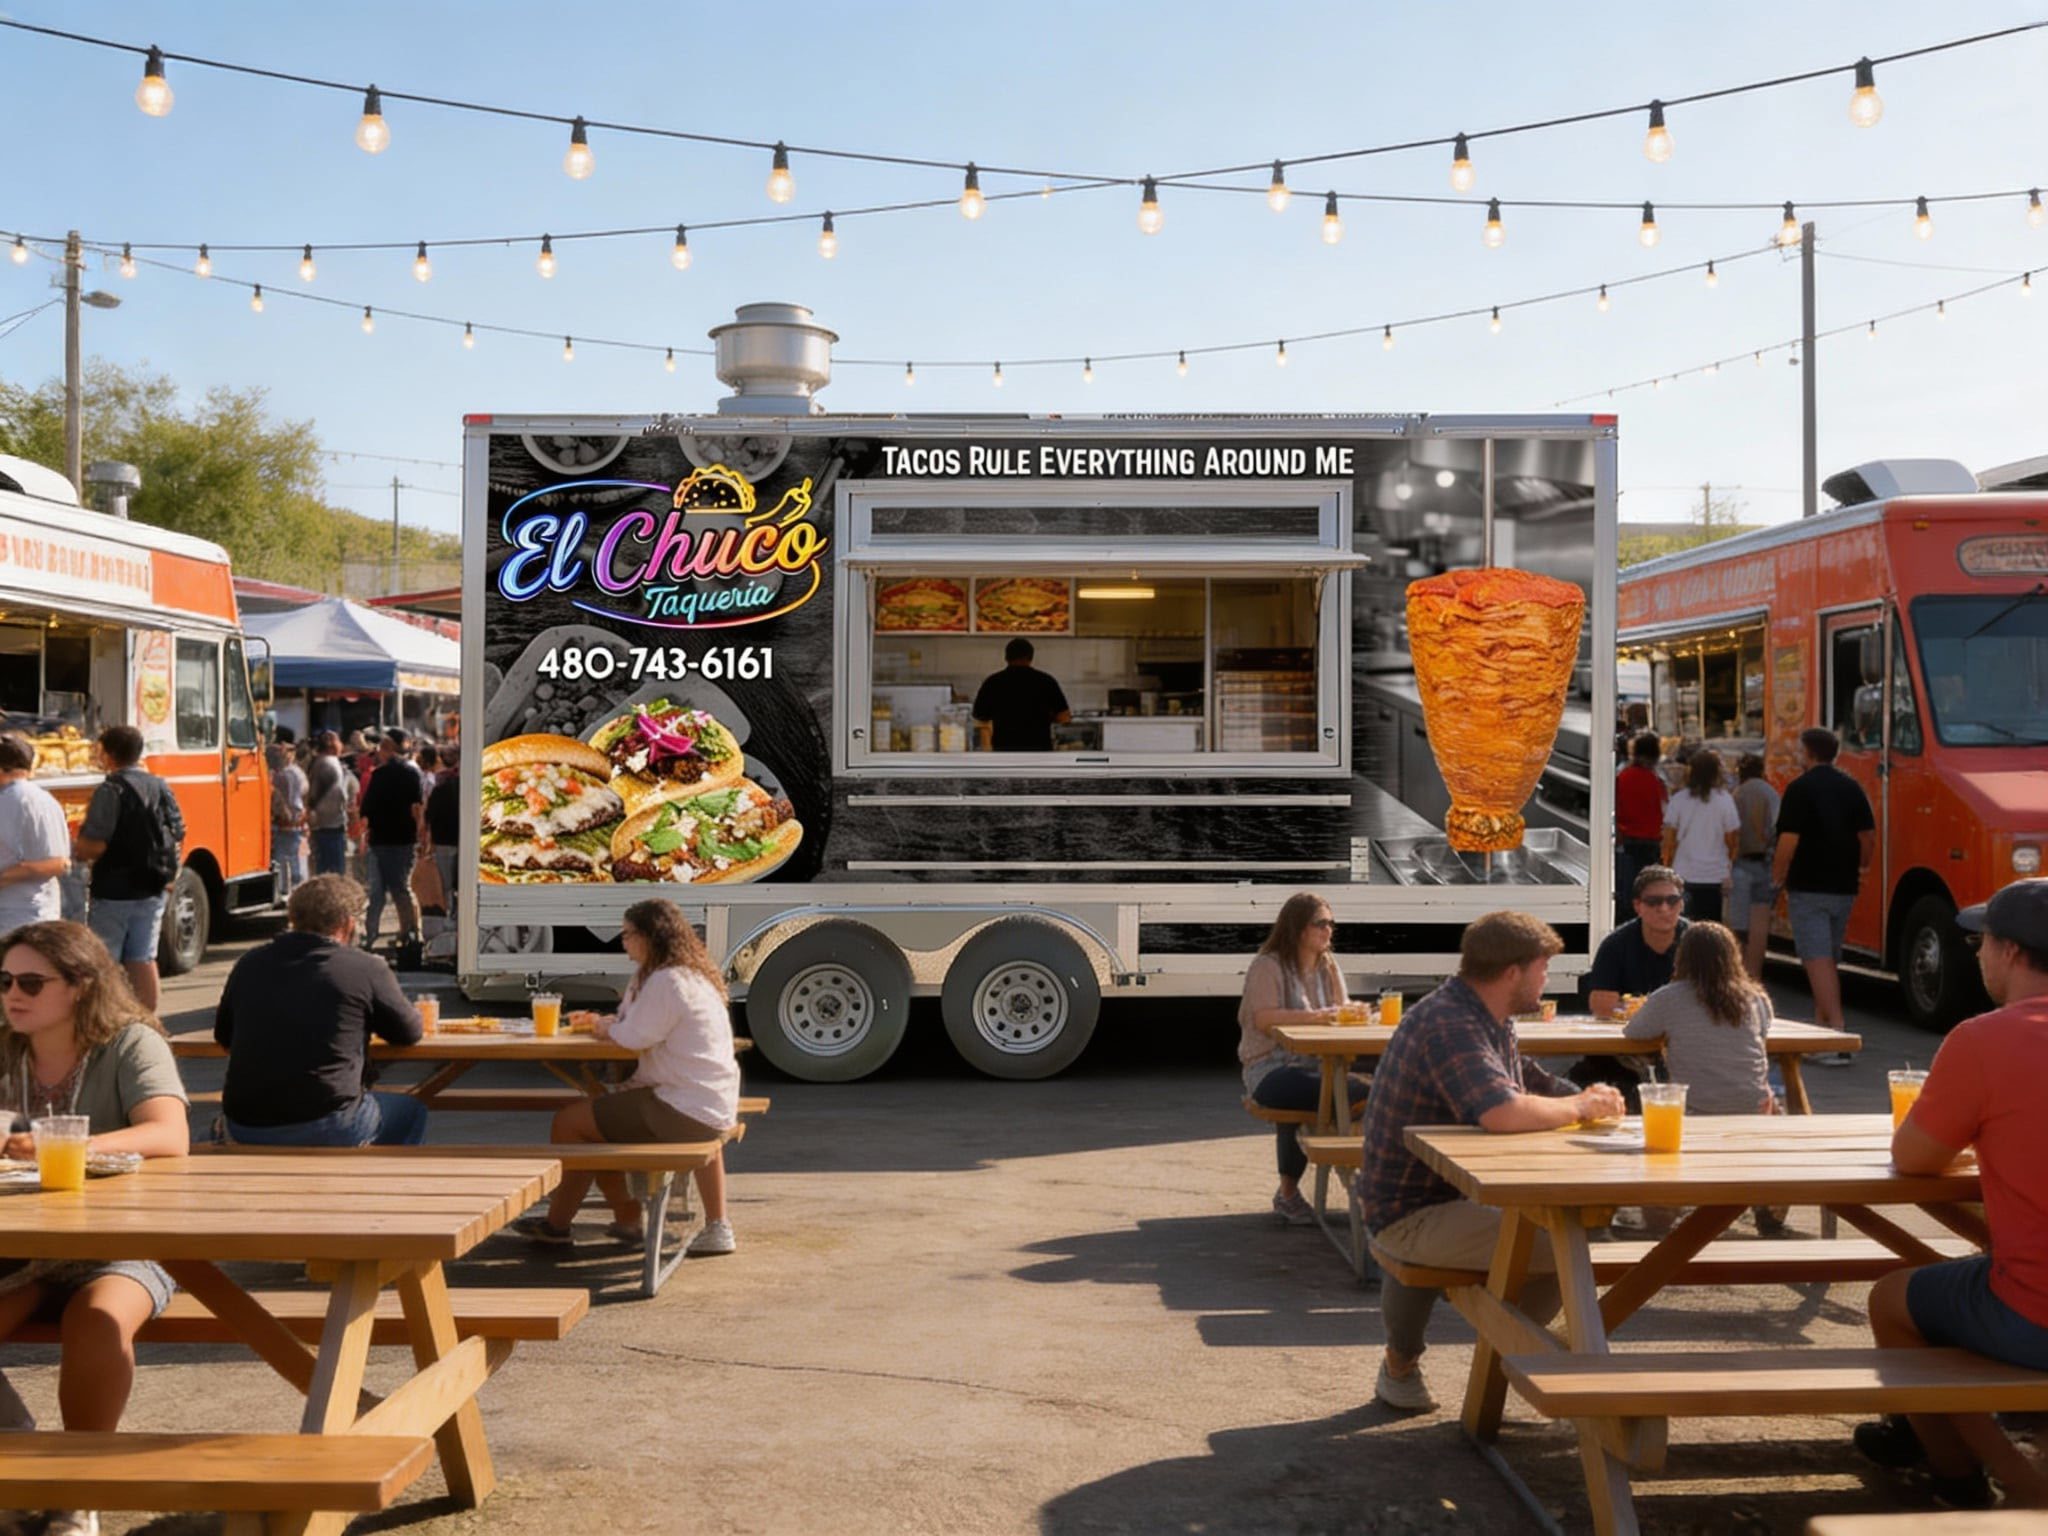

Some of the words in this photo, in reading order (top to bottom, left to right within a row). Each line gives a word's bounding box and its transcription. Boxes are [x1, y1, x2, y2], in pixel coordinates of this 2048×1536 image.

[882, 446, 961, 476] TACOS
[969, 446, 1031, 476] RULE
[1040, 446, 1195, 476] EVERYTHING
[1204, 446, 1306, 476] AROUND
[1315, 446, 1355, 475] ME
[499, 511, 588, 600] El
[594, 510, 827, 591] Chuco
[537, 646, 773, 680] 480-743-6161
